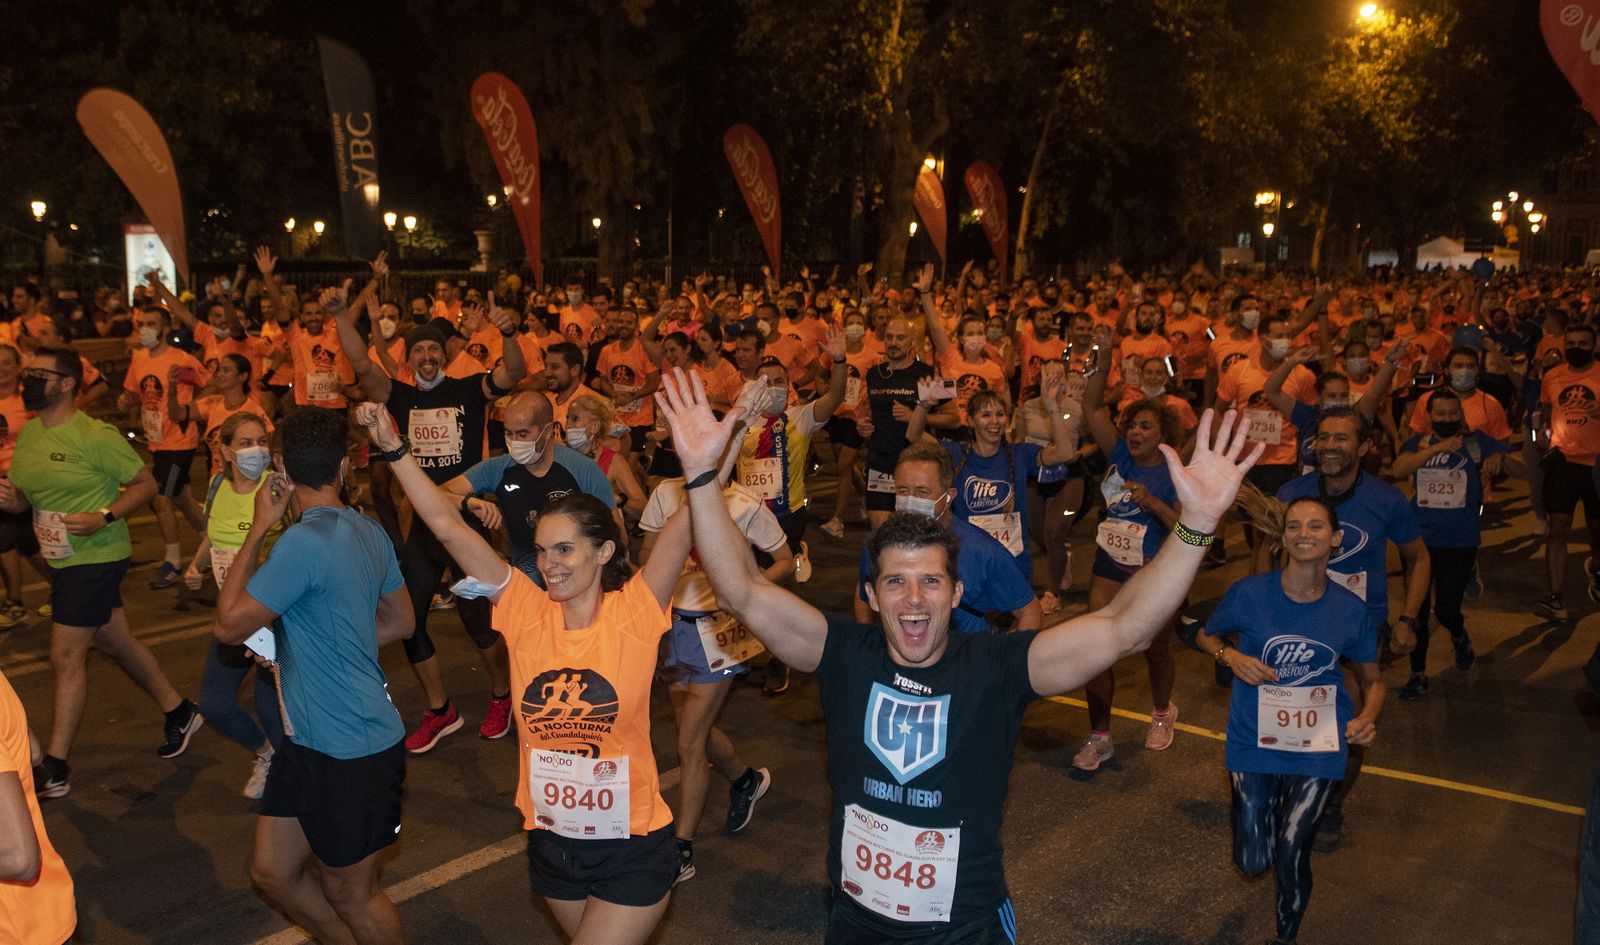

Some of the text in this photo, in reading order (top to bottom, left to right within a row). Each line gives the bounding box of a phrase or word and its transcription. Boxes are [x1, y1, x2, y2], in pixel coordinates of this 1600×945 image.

[414, 425, 450, 440] 6062
[417, 454, 463, 468] LLA 2015
[745, 473, 775, 487] 8261
[1428, 482, 1455, 495] 823
[1106, 532, 1131, 551] 833
[1274, 642, 1316, 665] life
[1276, 709, 1318, 728] 910
[528, 722, 612, 735] LA NOCTURNA
[539, 730, 603, 743] del Guadalquivir
[543, 782, 614, 812] 9840
[863, 777, 943, 809] URBAN HERO
[855, 843, 937, 891] 9848
